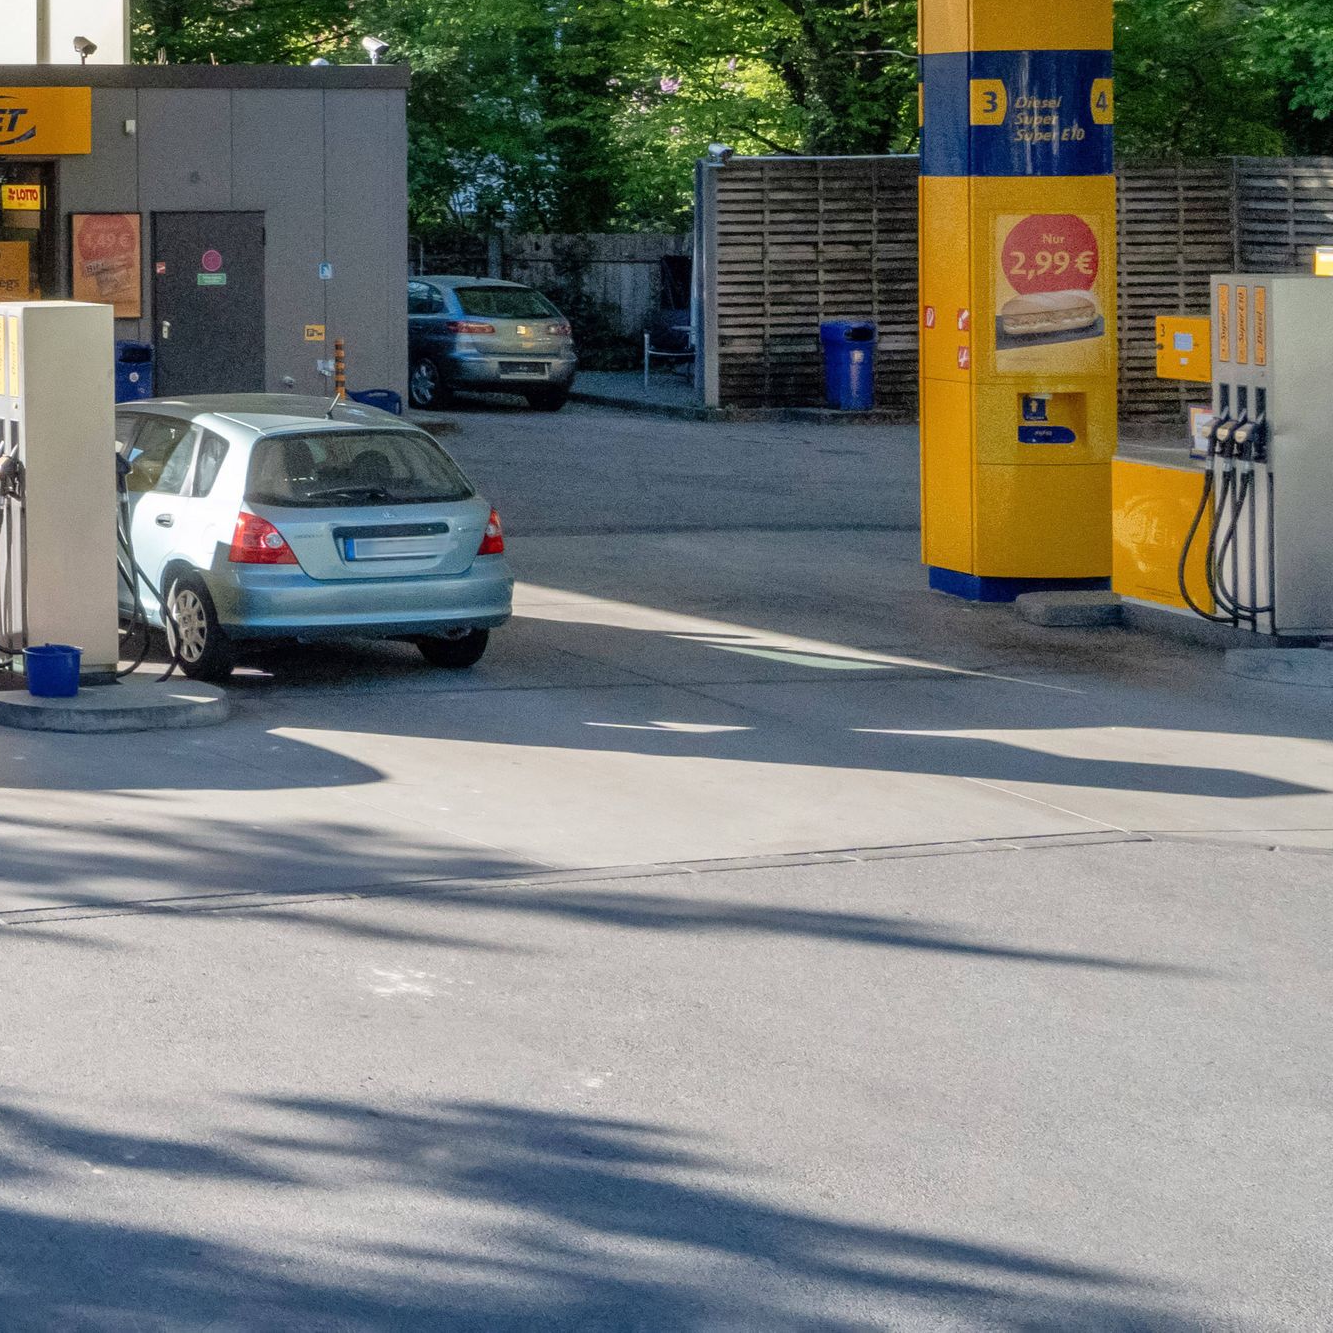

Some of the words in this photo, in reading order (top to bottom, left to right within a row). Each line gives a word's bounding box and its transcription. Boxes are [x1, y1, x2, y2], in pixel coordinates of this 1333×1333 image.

[983, 91, 997, 113] 3
[1015, 96, 1063, 108] Diesel
[1096, 91, 1108, 112] 4
[1014, 112, 1059, 128] Super
[1014, 128, 1057, 145] Super
[1061, 127, 1085, 141] E10
[16, 188, 39, 201] LOTTO
[1041, 233, 1065, 245] Nur
